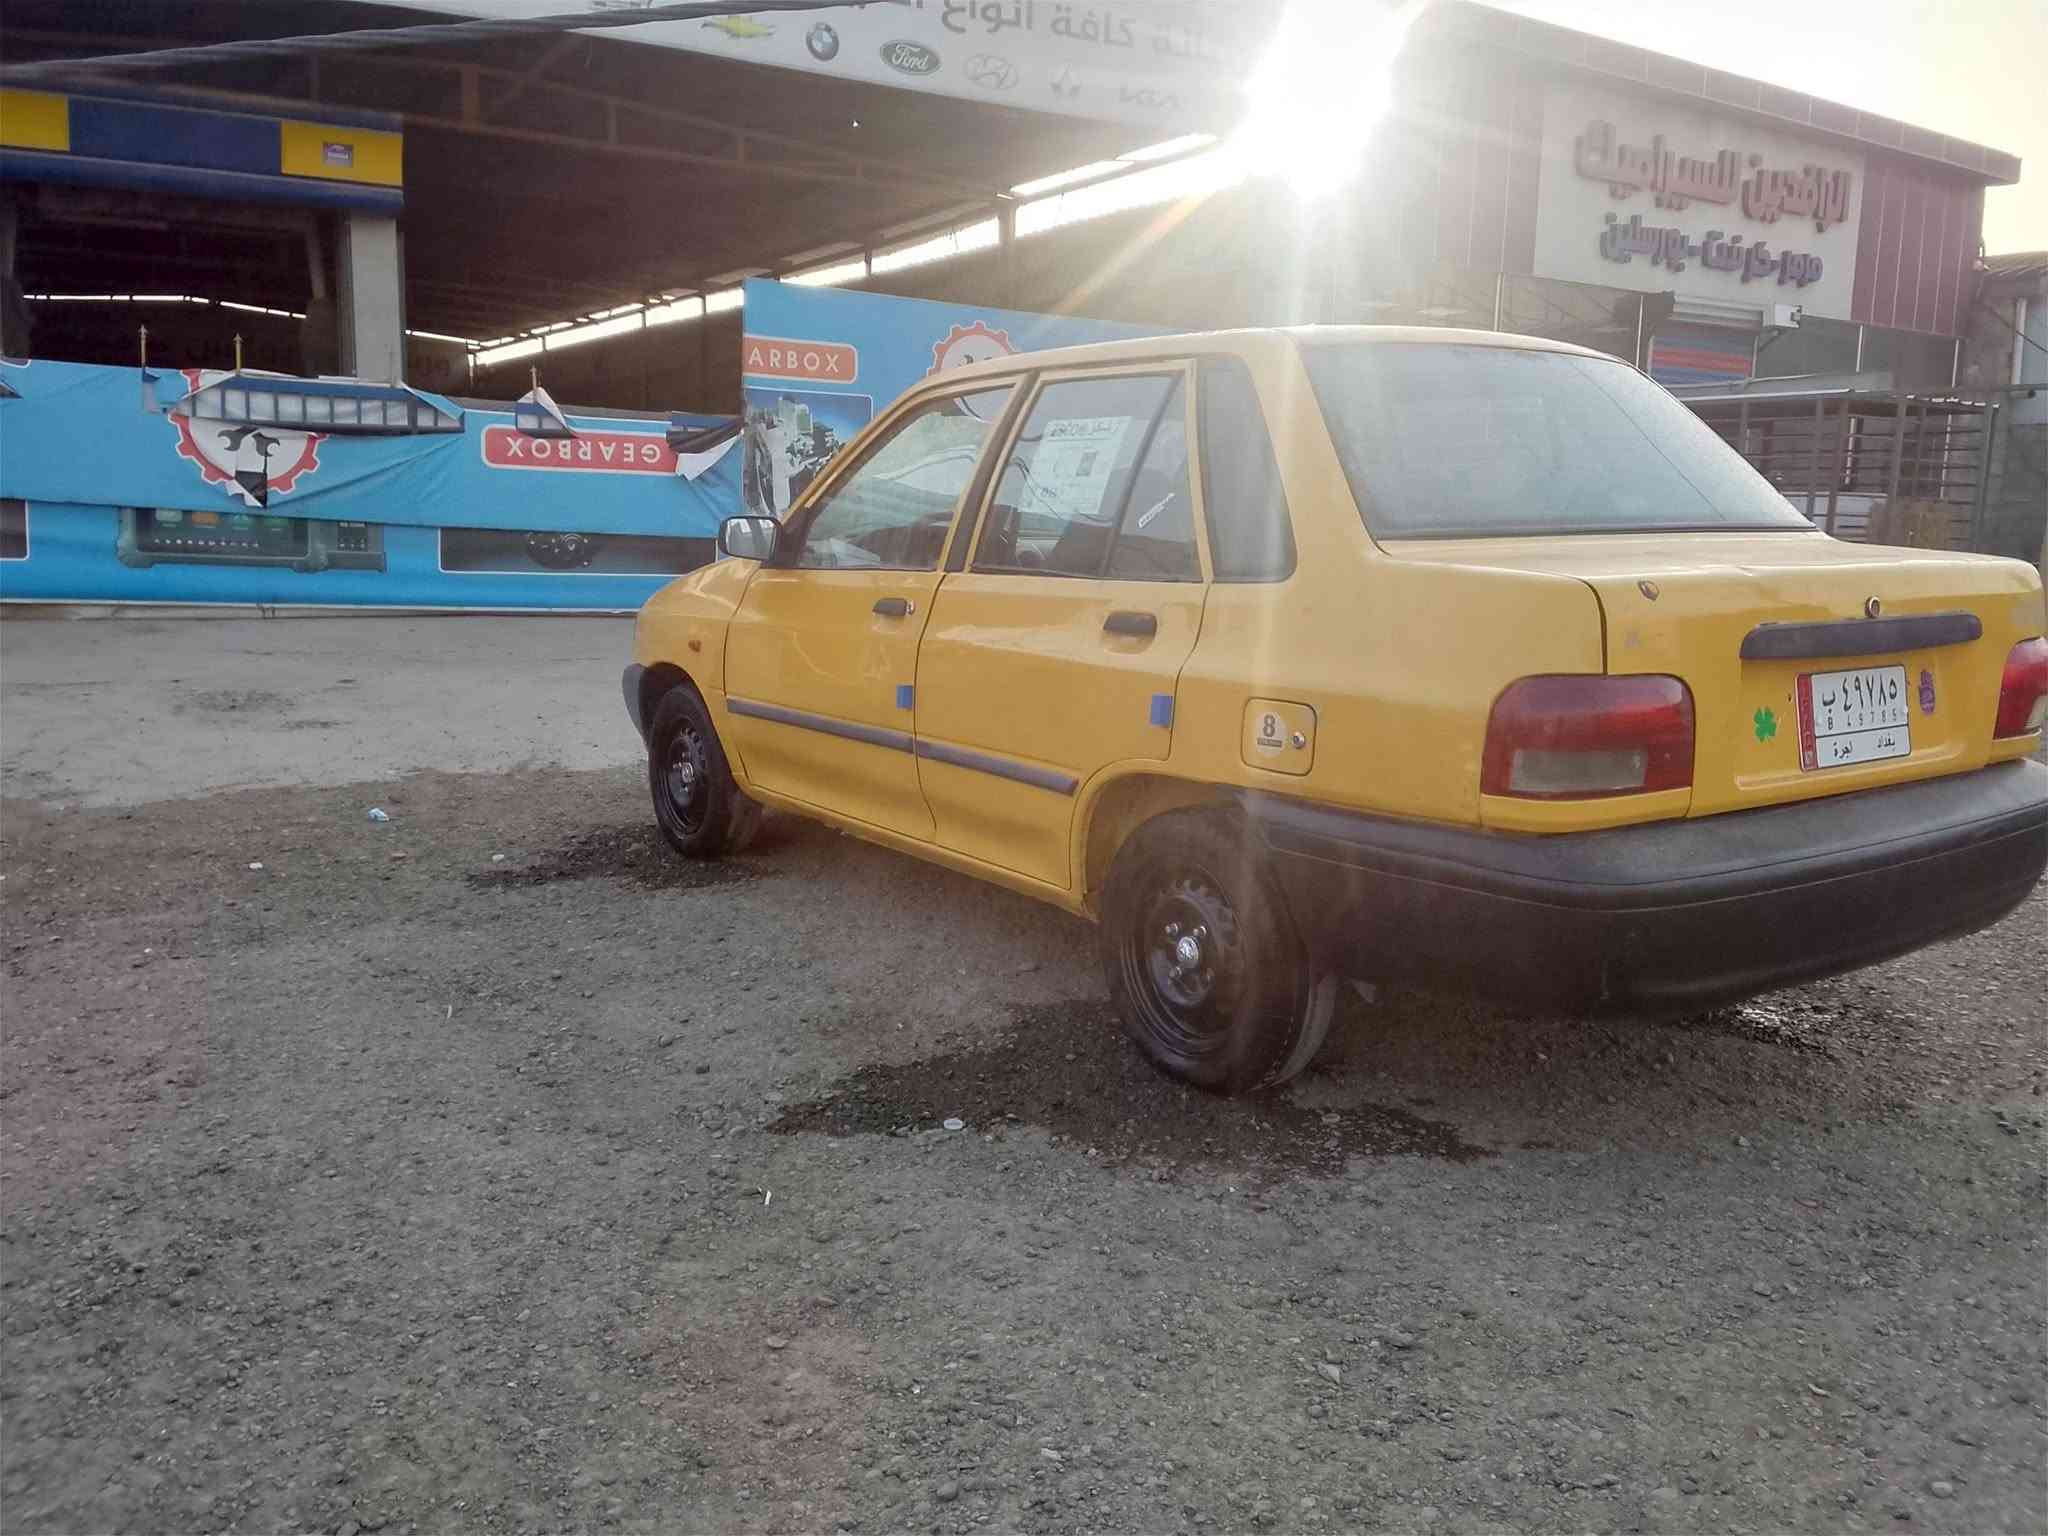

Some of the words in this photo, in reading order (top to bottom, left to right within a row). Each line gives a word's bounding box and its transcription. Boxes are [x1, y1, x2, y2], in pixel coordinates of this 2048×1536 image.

[1050, 5, 1136, 49] كافة
[889, 43, 931, 71] Ford
[1742, 154, 1852, 233] الرافدين
[506, 436, 662, 464] GEARBOX
[1262, 713, 1276, 738] 8
